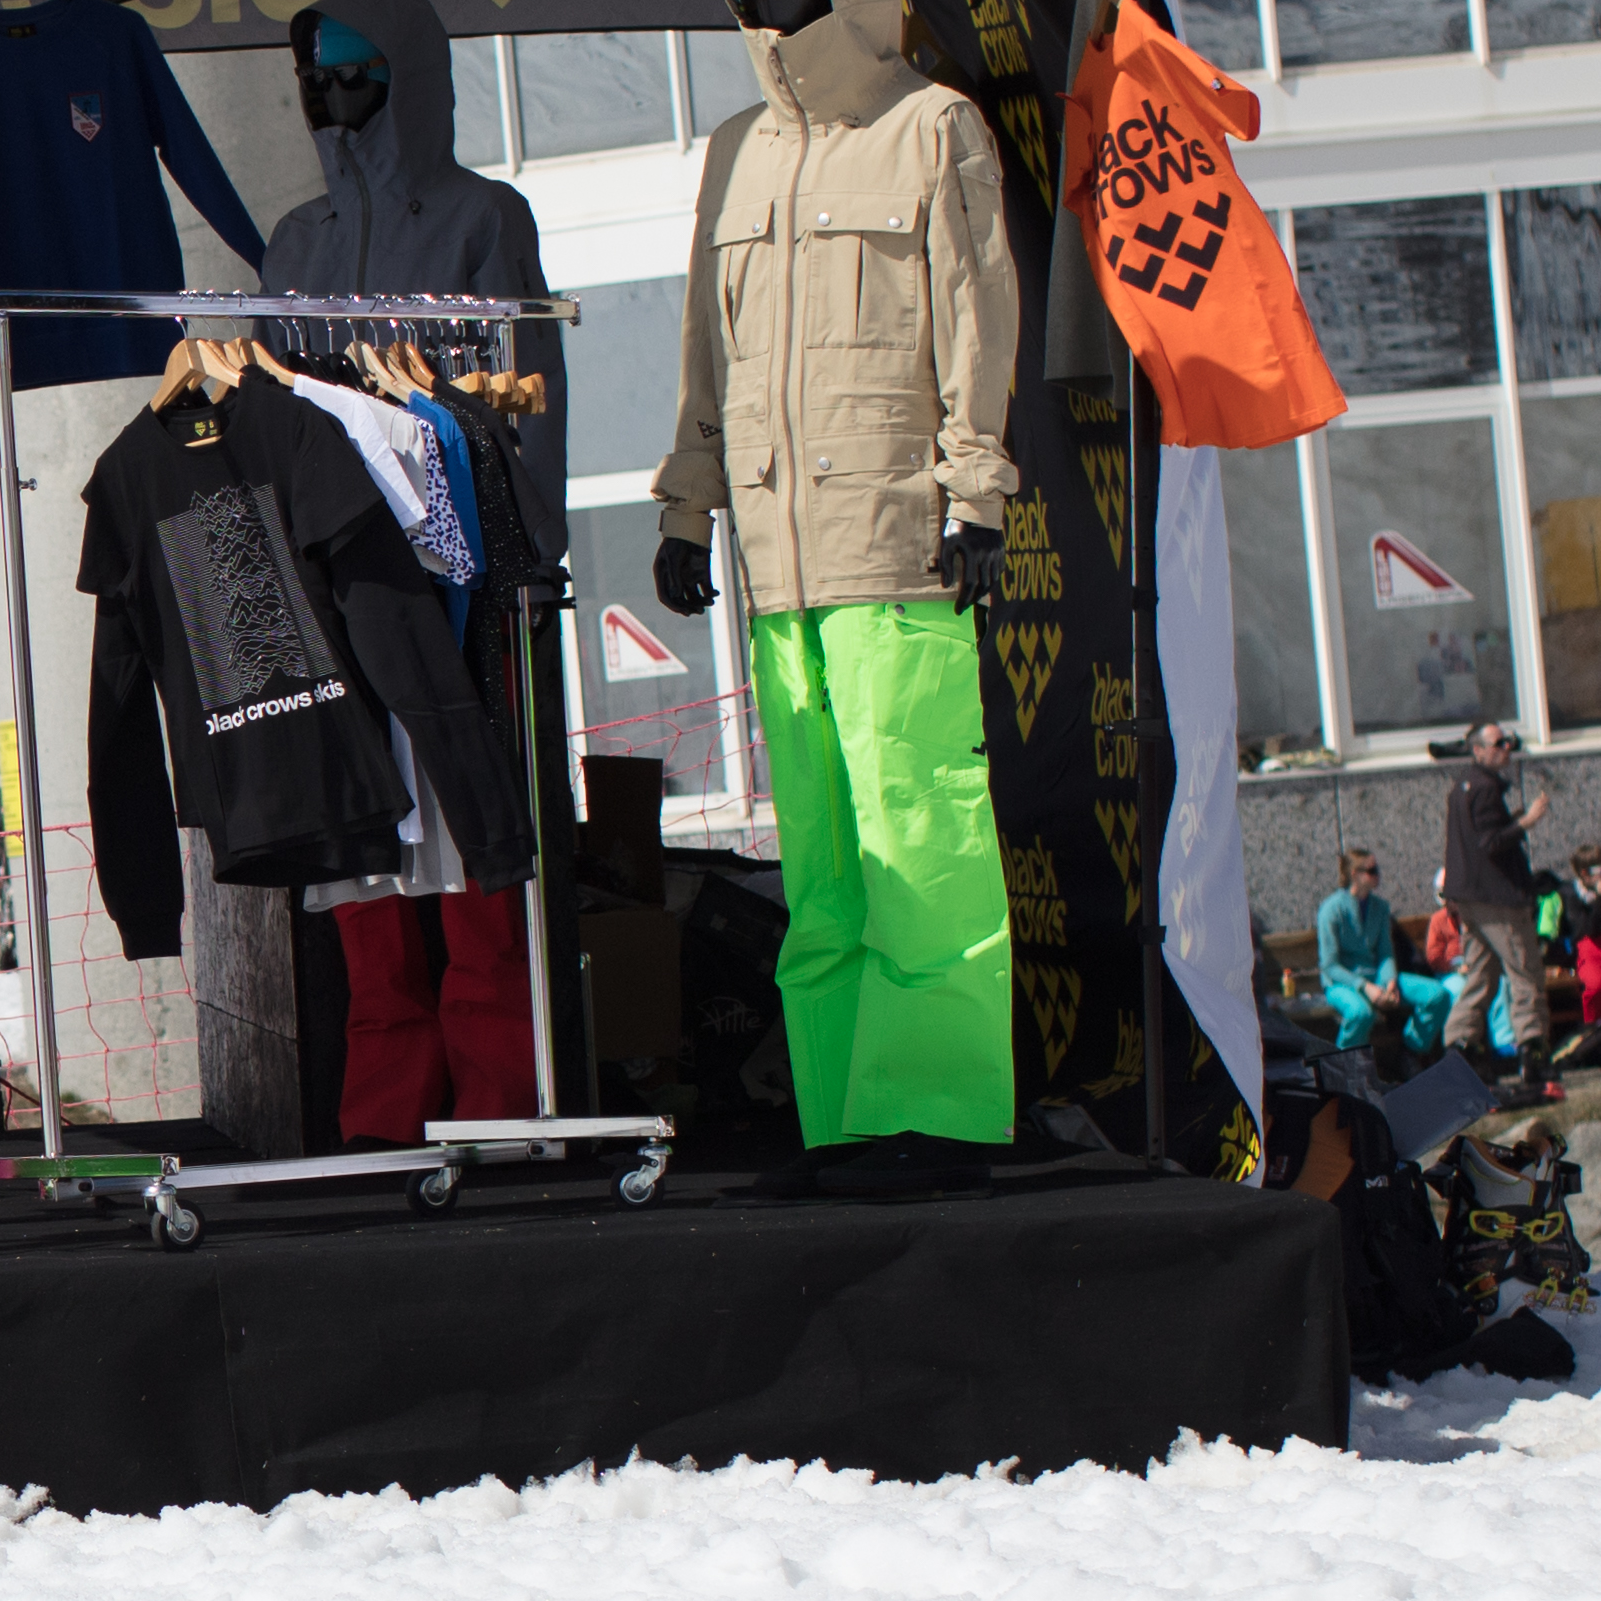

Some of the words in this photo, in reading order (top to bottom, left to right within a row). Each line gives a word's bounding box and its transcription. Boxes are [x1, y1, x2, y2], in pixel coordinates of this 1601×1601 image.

[1098, 98, 1185, 176] ack
[1097, 139, 1216, 221] rows
[1001, 550, 1063, 601] crows
[246, 691, 313, 722] crows
[313, 678, 346, 704] skis
[1091, 661, 1136, 727] blac
